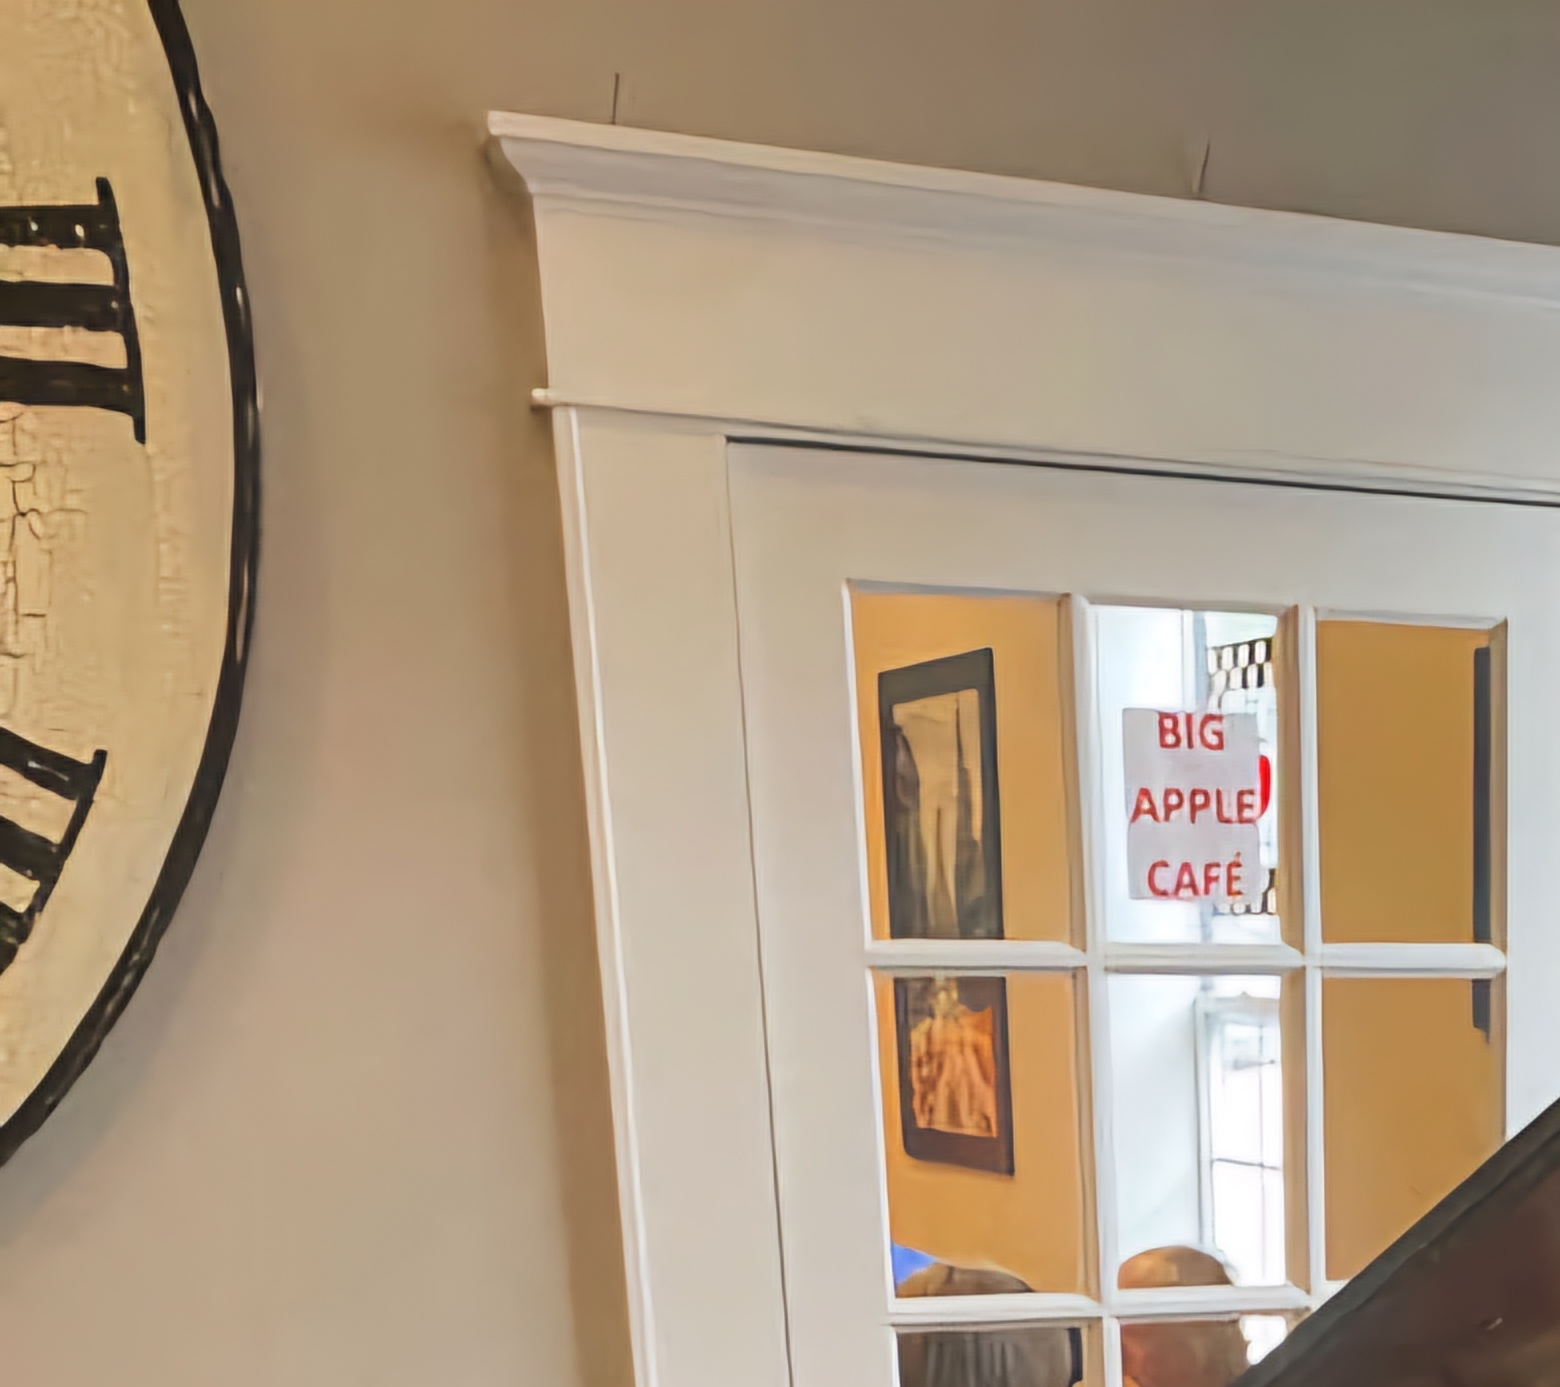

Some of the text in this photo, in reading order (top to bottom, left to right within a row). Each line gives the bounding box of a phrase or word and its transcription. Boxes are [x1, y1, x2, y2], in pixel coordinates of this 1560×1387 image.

[1157, 712, 1225, 751] BIG
[1129, 787, 1257, 825] APPLE
[1147, 852, 1245, 898] CAFÉ
